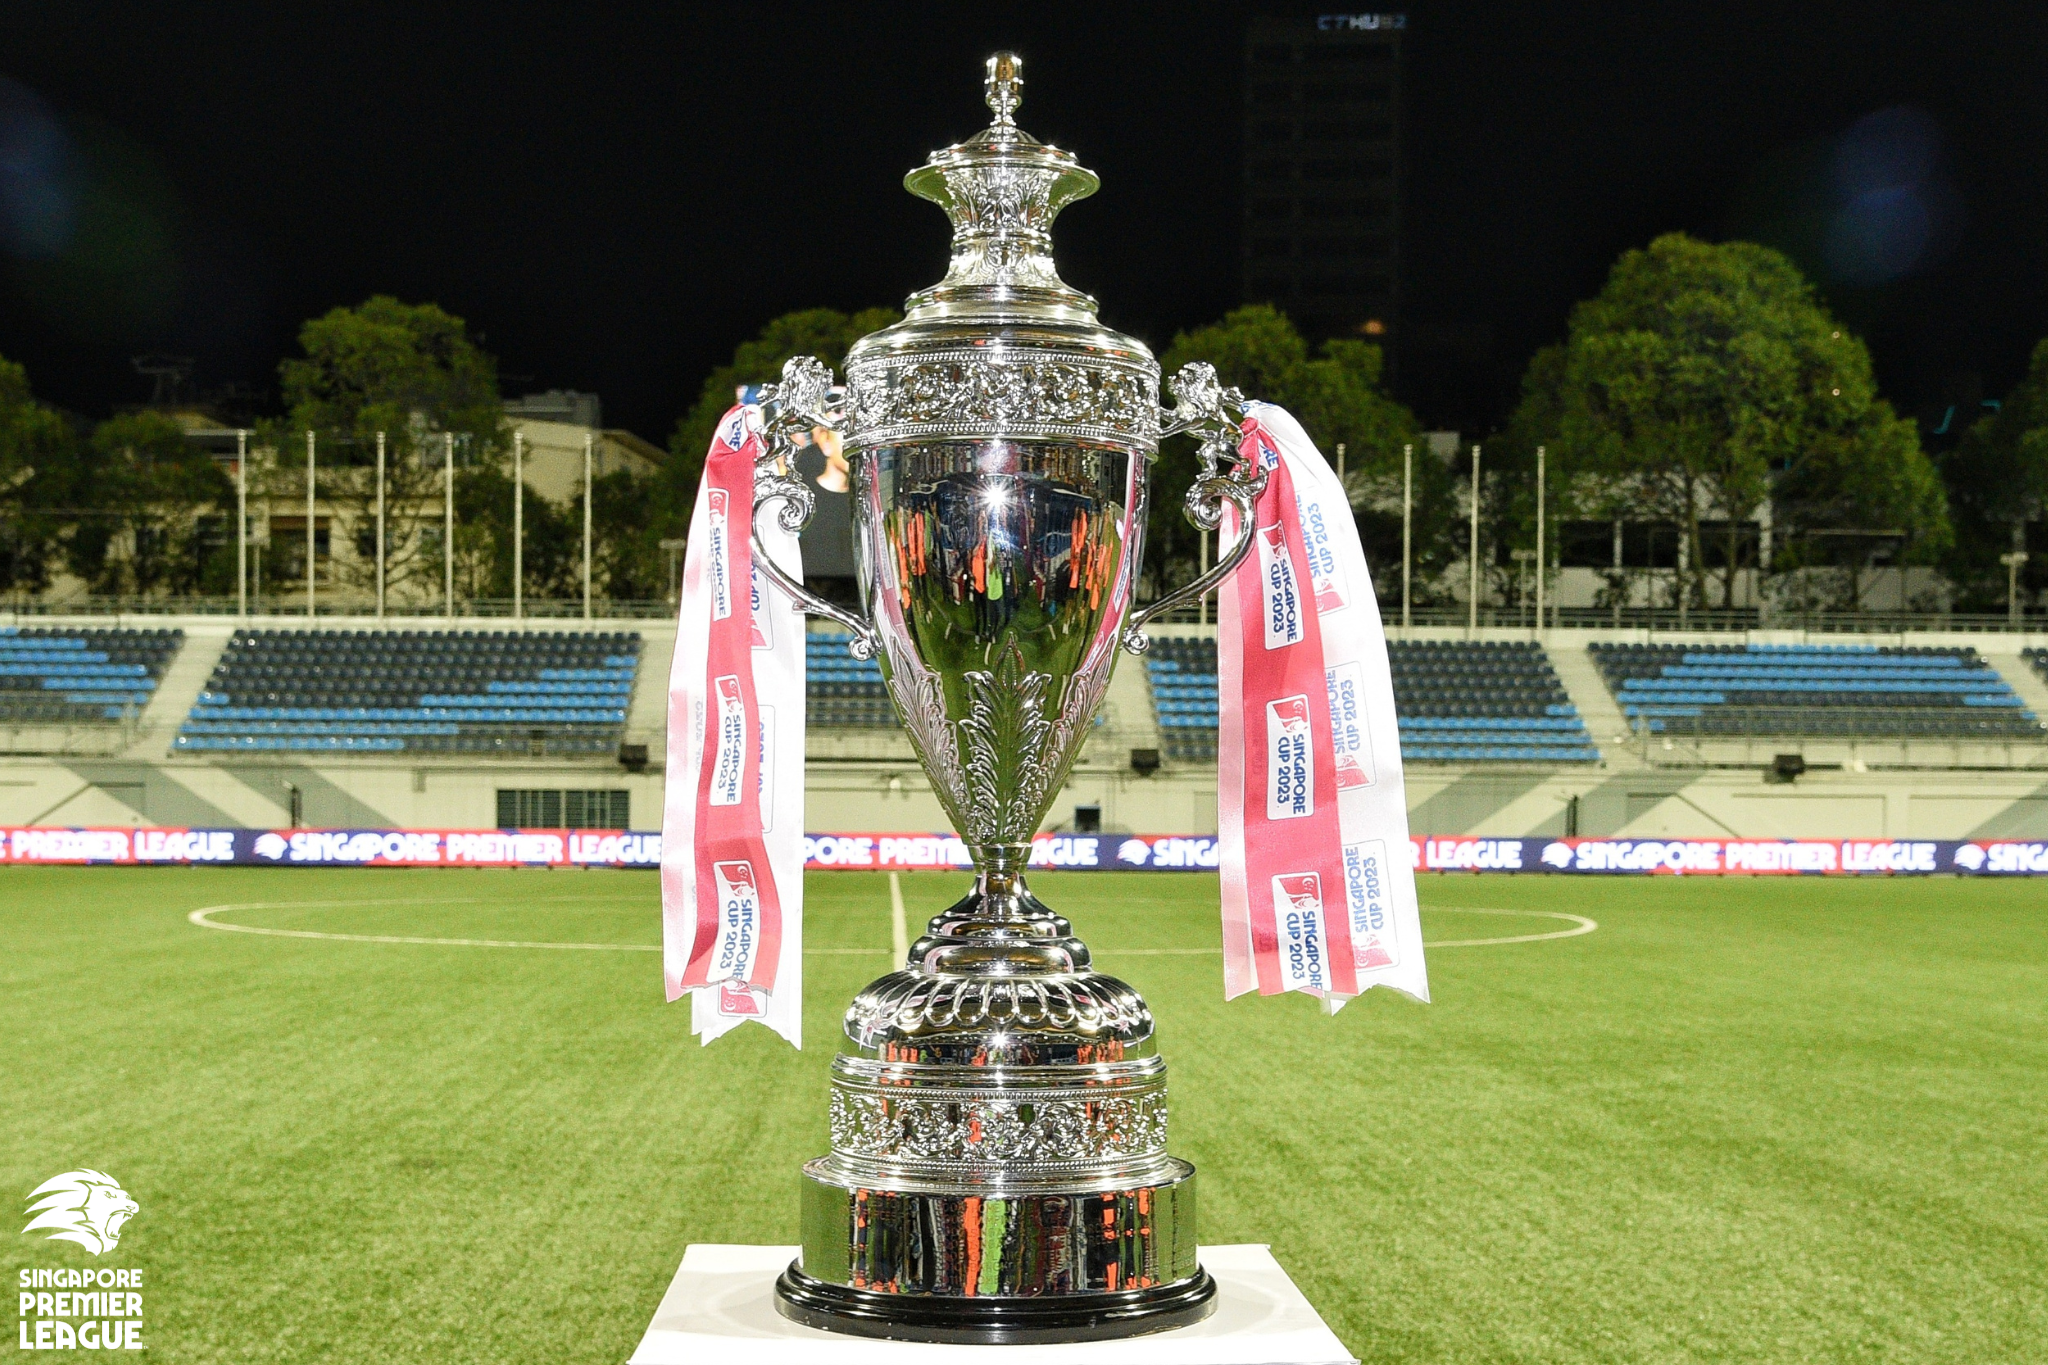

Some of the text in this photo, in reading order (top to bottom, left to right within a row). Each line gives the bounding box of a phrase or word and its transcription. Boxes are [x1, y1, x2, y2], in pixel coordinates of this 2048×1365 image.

[1307, 503, 1334, 574] CUP 2023
[1270, 563, 1284, 634] CUP 2023
[1280, 558, 1297, 642] SINGAPORE
[1340, 679, 1360, 751] CUP 2023
[718, 716, 732, 789] CUP 2023
[726, 714, 741, 802] SINGAPORE
[1277, 736, 1290, 804] CUP 2023
[1292, 734, 1306, 814] SINGAPORE
[134, 831, 235, 860] LEAGUE
[289, 832, 662, 863] SINGAPORE PREMIER LEAGUE
[1426, 841, 1522, 868] LEAGUE
[1575, 841, 1936, 871] SINGAPORE PREMIER LEAGUE
[1345, 846, 1368, 934] SINGAPORE
[1363, 856, 1384, 930] CUP 2023
[720, 900, 738, 969] CUP 2023
[732, 898, 752, 980] SINGAPORE
[1286, 912, 1305, 980] CUP 2023
[1302, 910, 1322, 990] SINGAPORE
